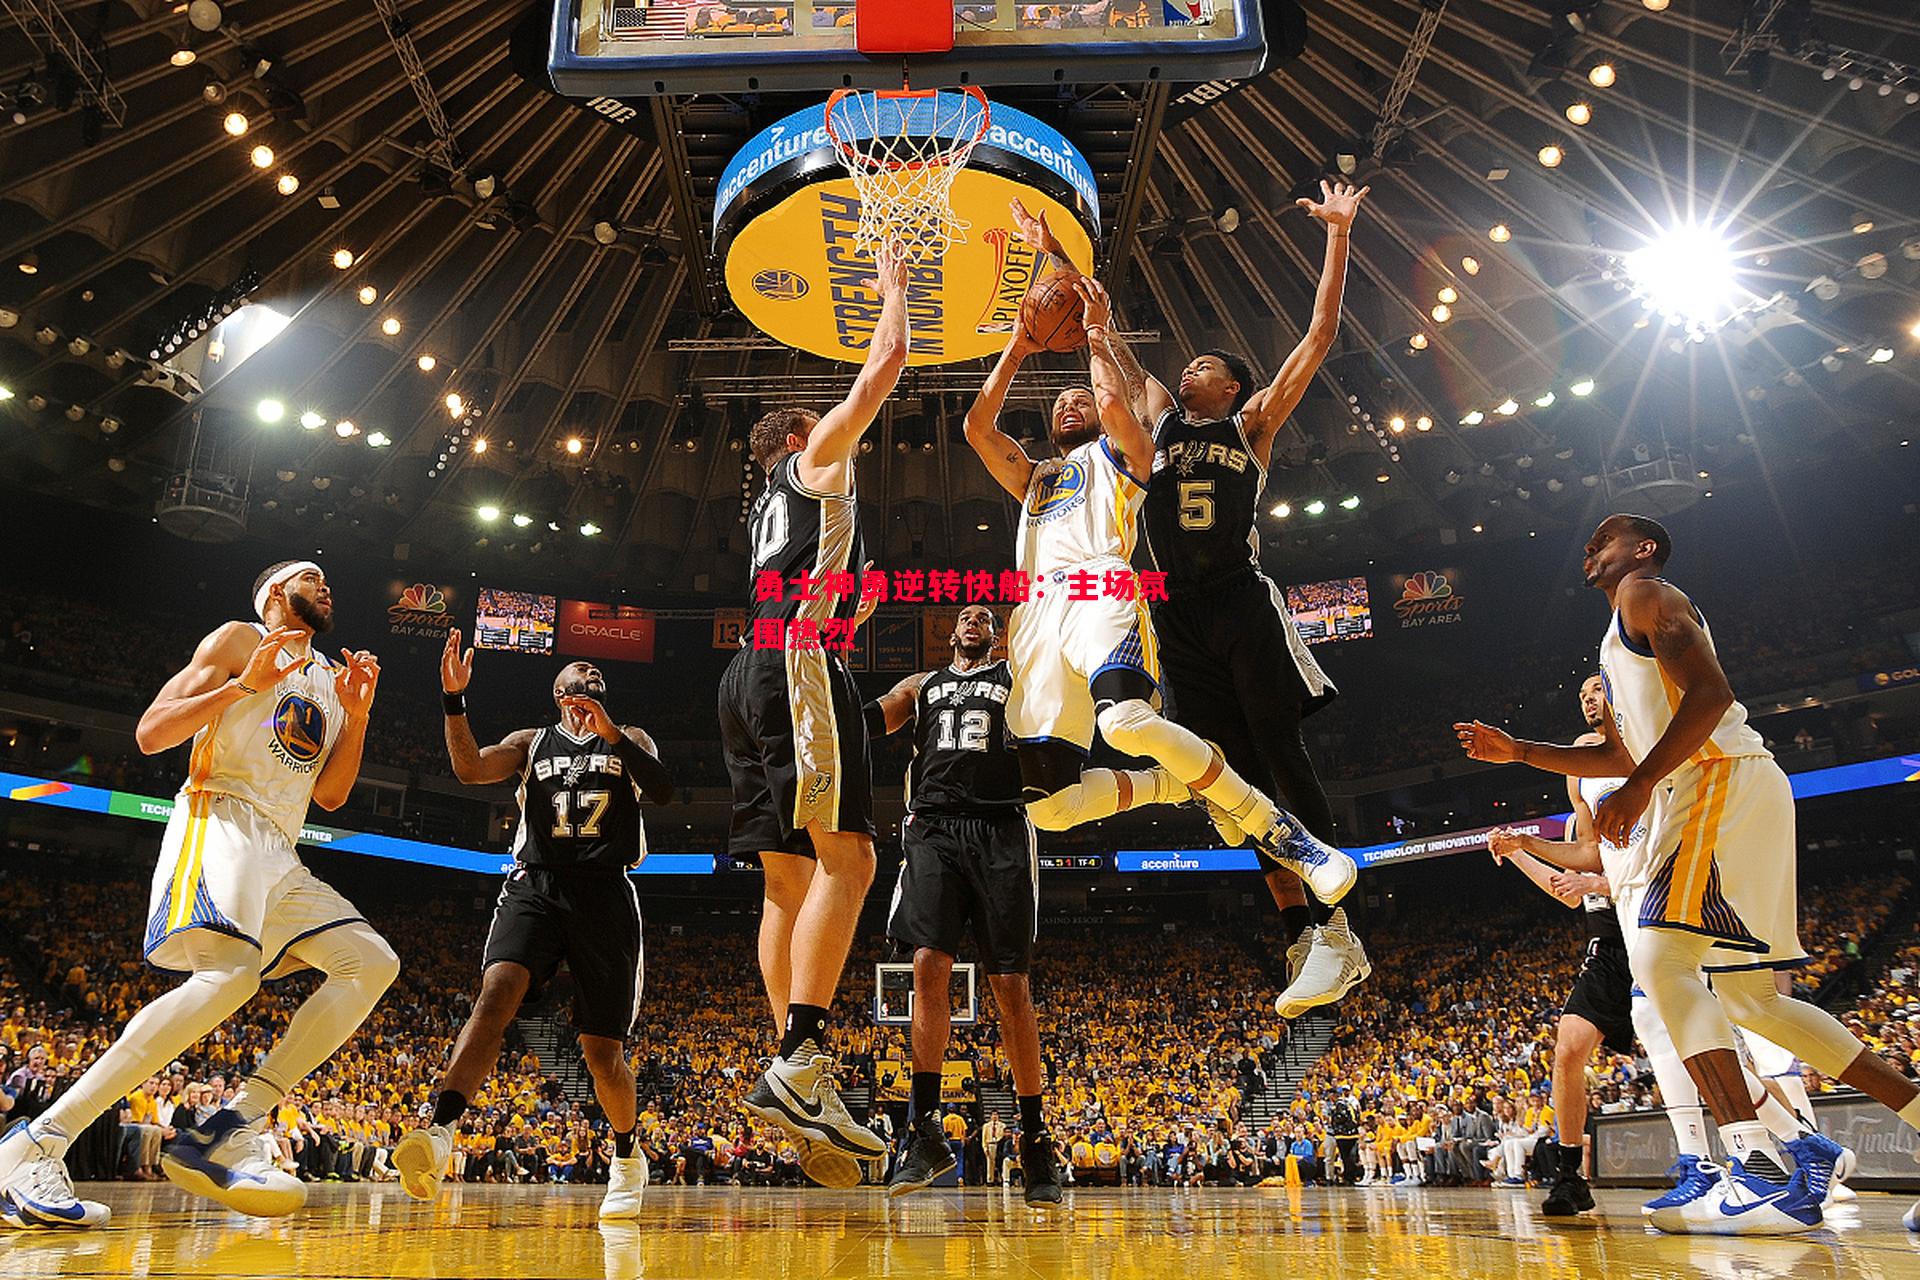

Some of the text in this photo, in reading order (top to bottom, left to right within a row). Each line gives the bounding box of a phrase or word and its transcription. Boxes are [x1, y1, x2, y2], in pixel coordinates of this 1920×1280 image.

[720, 125, 829, 207] accenture
[819, 191, 886, 349] STRENGTH
[908, 337, 944, 355] IN
[1152, 439, 1249, 477] SPURS
[1177, 480, 1216, 531] 5
[388, 603, 456, 628] Sports
[1392, 594, 1465, 620] Sports
[391, 624, 448, 640] BAY AREA
[570, 623, 642, 641] ORACLE
[1401, 613, 1462, 628] BAY AREA
[719, 624, 741, 644] 13
[927, 680, 1009, 706] SPURS
[936, 709, 991, 752] 12
[533, 753, 623, 787] SPURS
[551, 789, 612, 838] 17
[300, 829, 332, 842] RTNER
[1363, 844, 1426, 862] TECHNOLOGY
[1428, 832, 1489, 852] INNOVATION
[1078, 859, 1088, 868] TF
[1141, 857, 1199, 869] accenture
